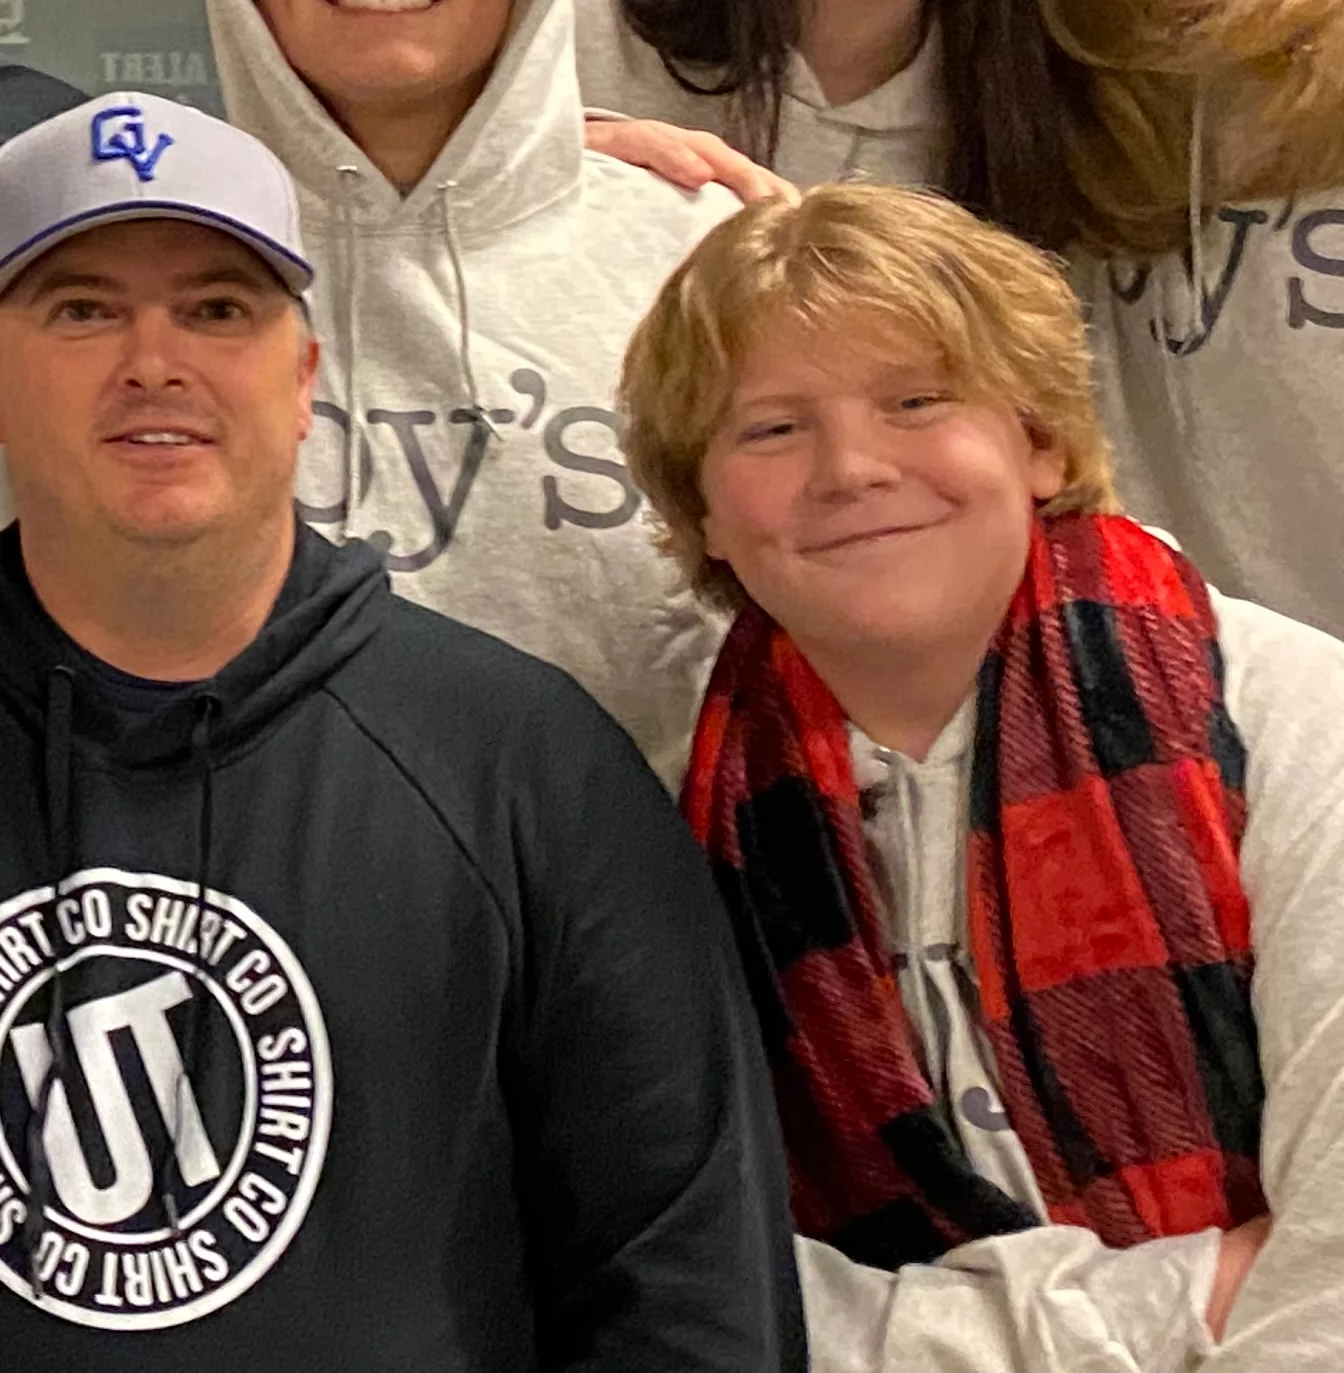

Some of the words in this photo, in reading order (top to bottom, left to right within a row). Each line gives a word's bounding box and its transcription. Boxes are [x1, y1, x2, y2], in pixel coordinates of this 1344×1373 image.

[295, 368, 642, 573] oy's
[56, 888, 112, 945] CO
[124, 893, 247, 965] SHIRT
[225, 949, 288, 1016] CO
[255, 1027, 311, 1176] SHIRT
[223, 1172, 288, 1243] CO
[36, 1230, 90, 1296] CO
[94, 1229, 229, 1307] SHIRT
